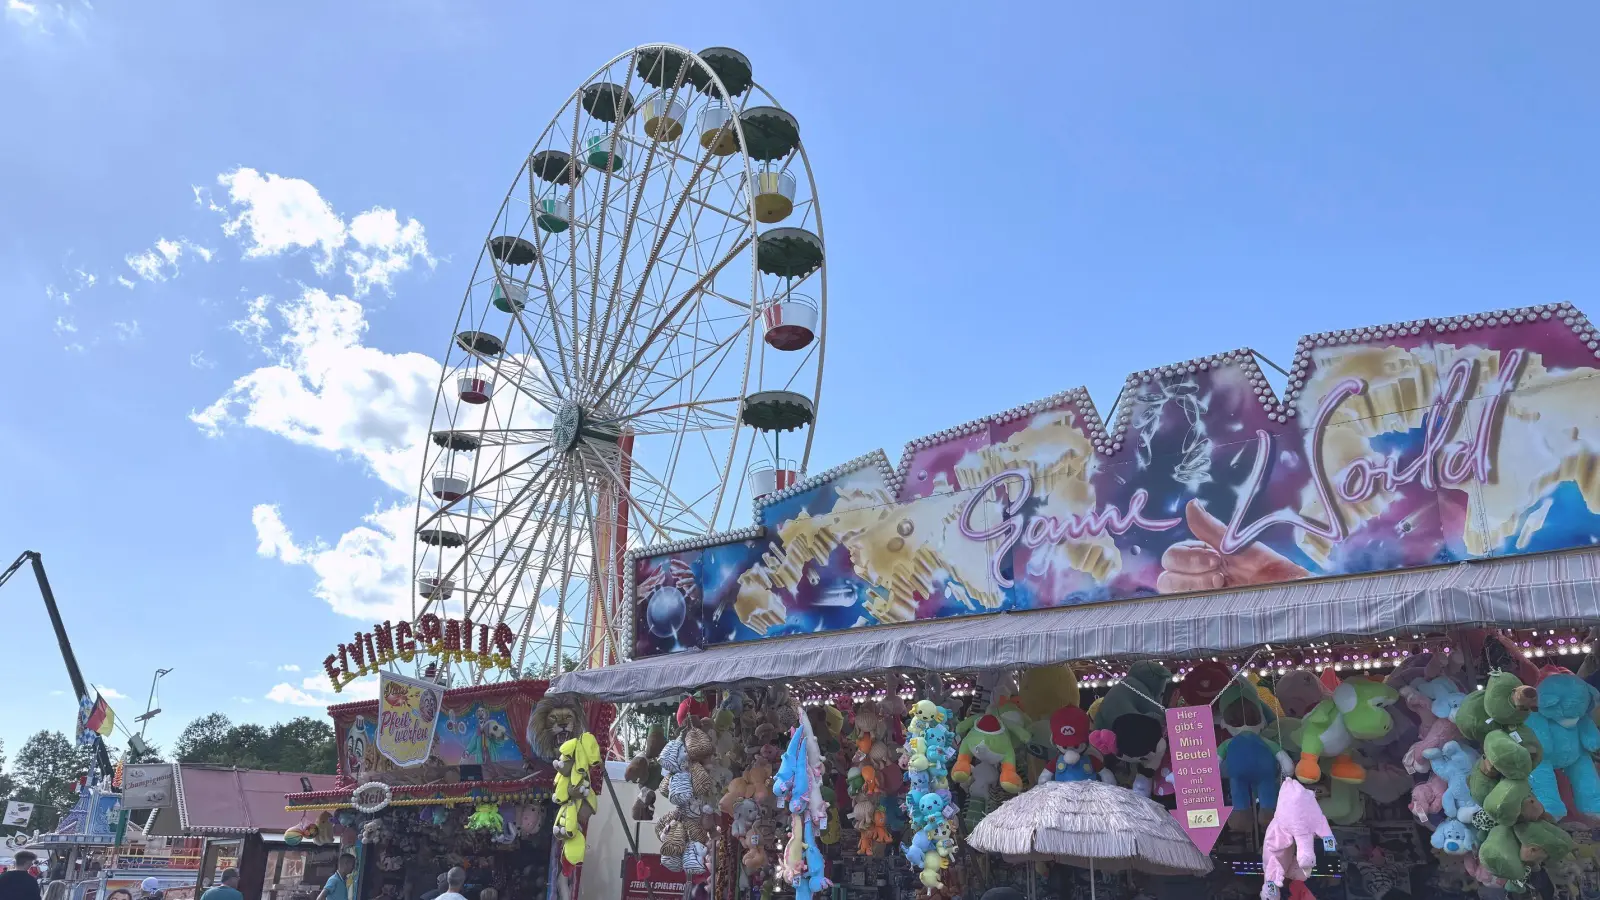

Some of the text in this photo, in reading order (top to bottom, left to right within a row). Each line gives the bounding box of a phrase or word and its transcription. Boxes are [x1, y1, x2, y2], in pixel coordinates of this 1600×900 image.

[959, 349, 1524, 588] Game World
[1176, 710, 1198, 720] Hier
[394, 719, 429, 744] werfen
[1179, 735, 1203, 748] Mini
[1175, 748, 1211, 761] Beutel
[1177, 767, 1213, 776] 40 Lose
[124, 772, 173, 790] Champignons
[1190, 776, 1204, 785] mit
[1181, 786, 1215, 795] Gewinn-
[1182, 795, 1216, 806] garantie
